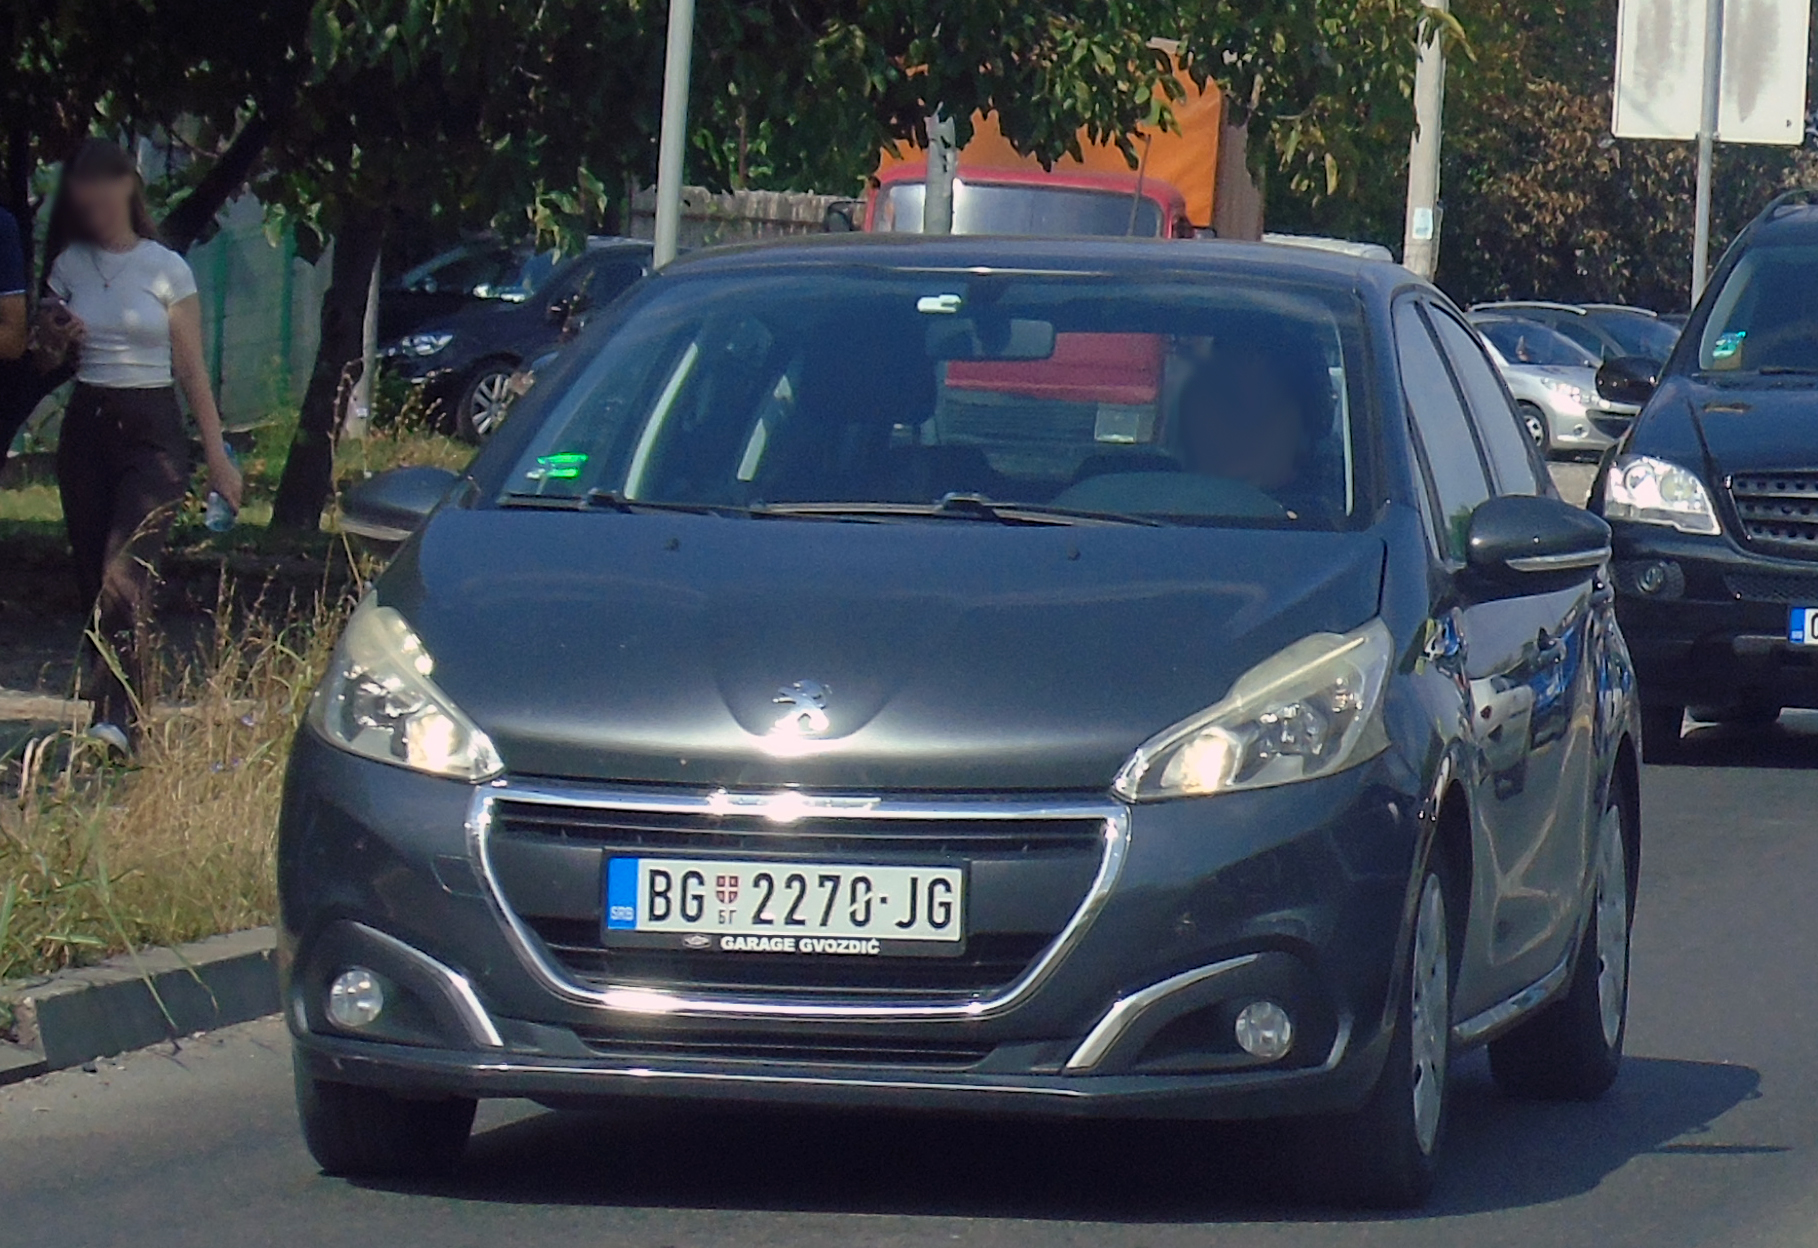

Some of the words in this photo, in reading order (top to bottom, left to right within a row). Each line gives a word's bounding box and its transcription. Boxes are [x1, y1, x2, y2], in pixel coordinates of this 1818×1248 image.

[648, 869, 705, 922] BG
[720, 936, 796, 952] GARAGE
[799, 938, 880, 955] GVOZDIĆ
